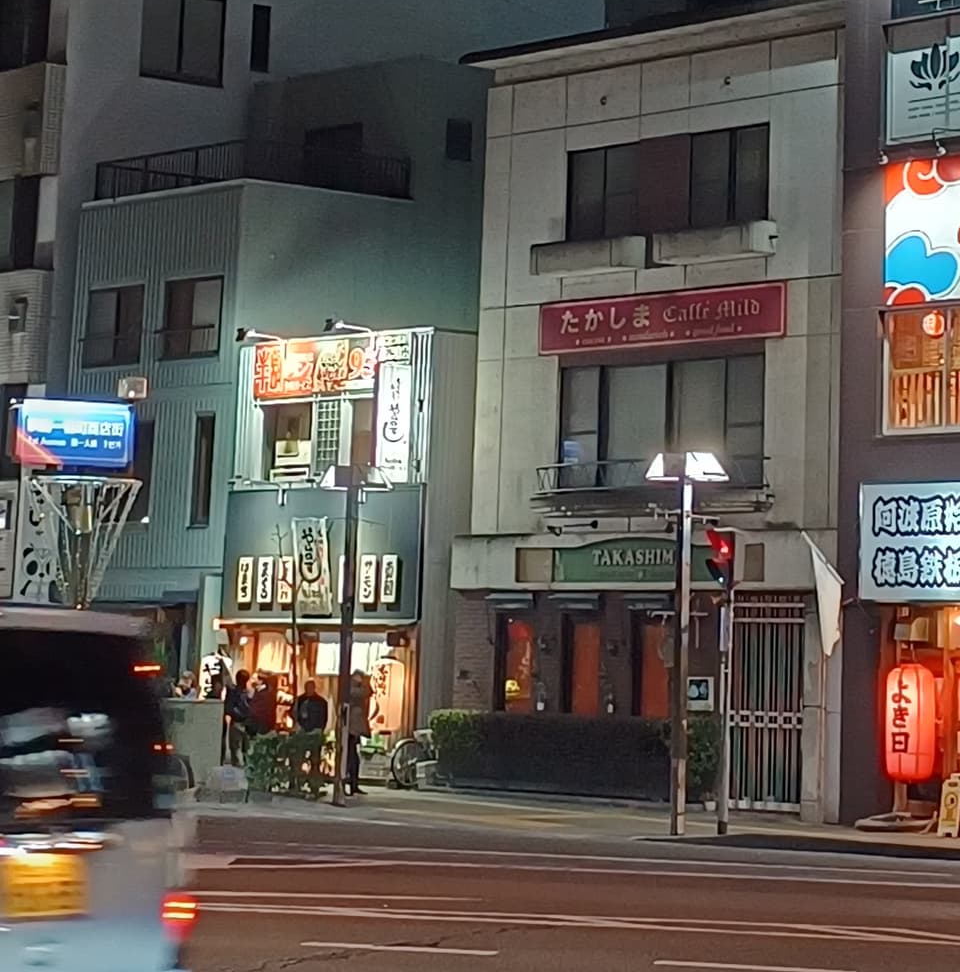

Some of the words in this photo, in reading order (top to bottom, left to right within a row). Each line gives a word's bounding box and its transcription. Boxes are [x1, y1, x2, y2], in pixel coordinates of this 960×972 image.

[560, 303, 651, 334] たかしま
[715, 299, 760, 321] Mild
[592, 548, 674, 566] TAKASHIM
[891, 675, 911, 754] よき日
